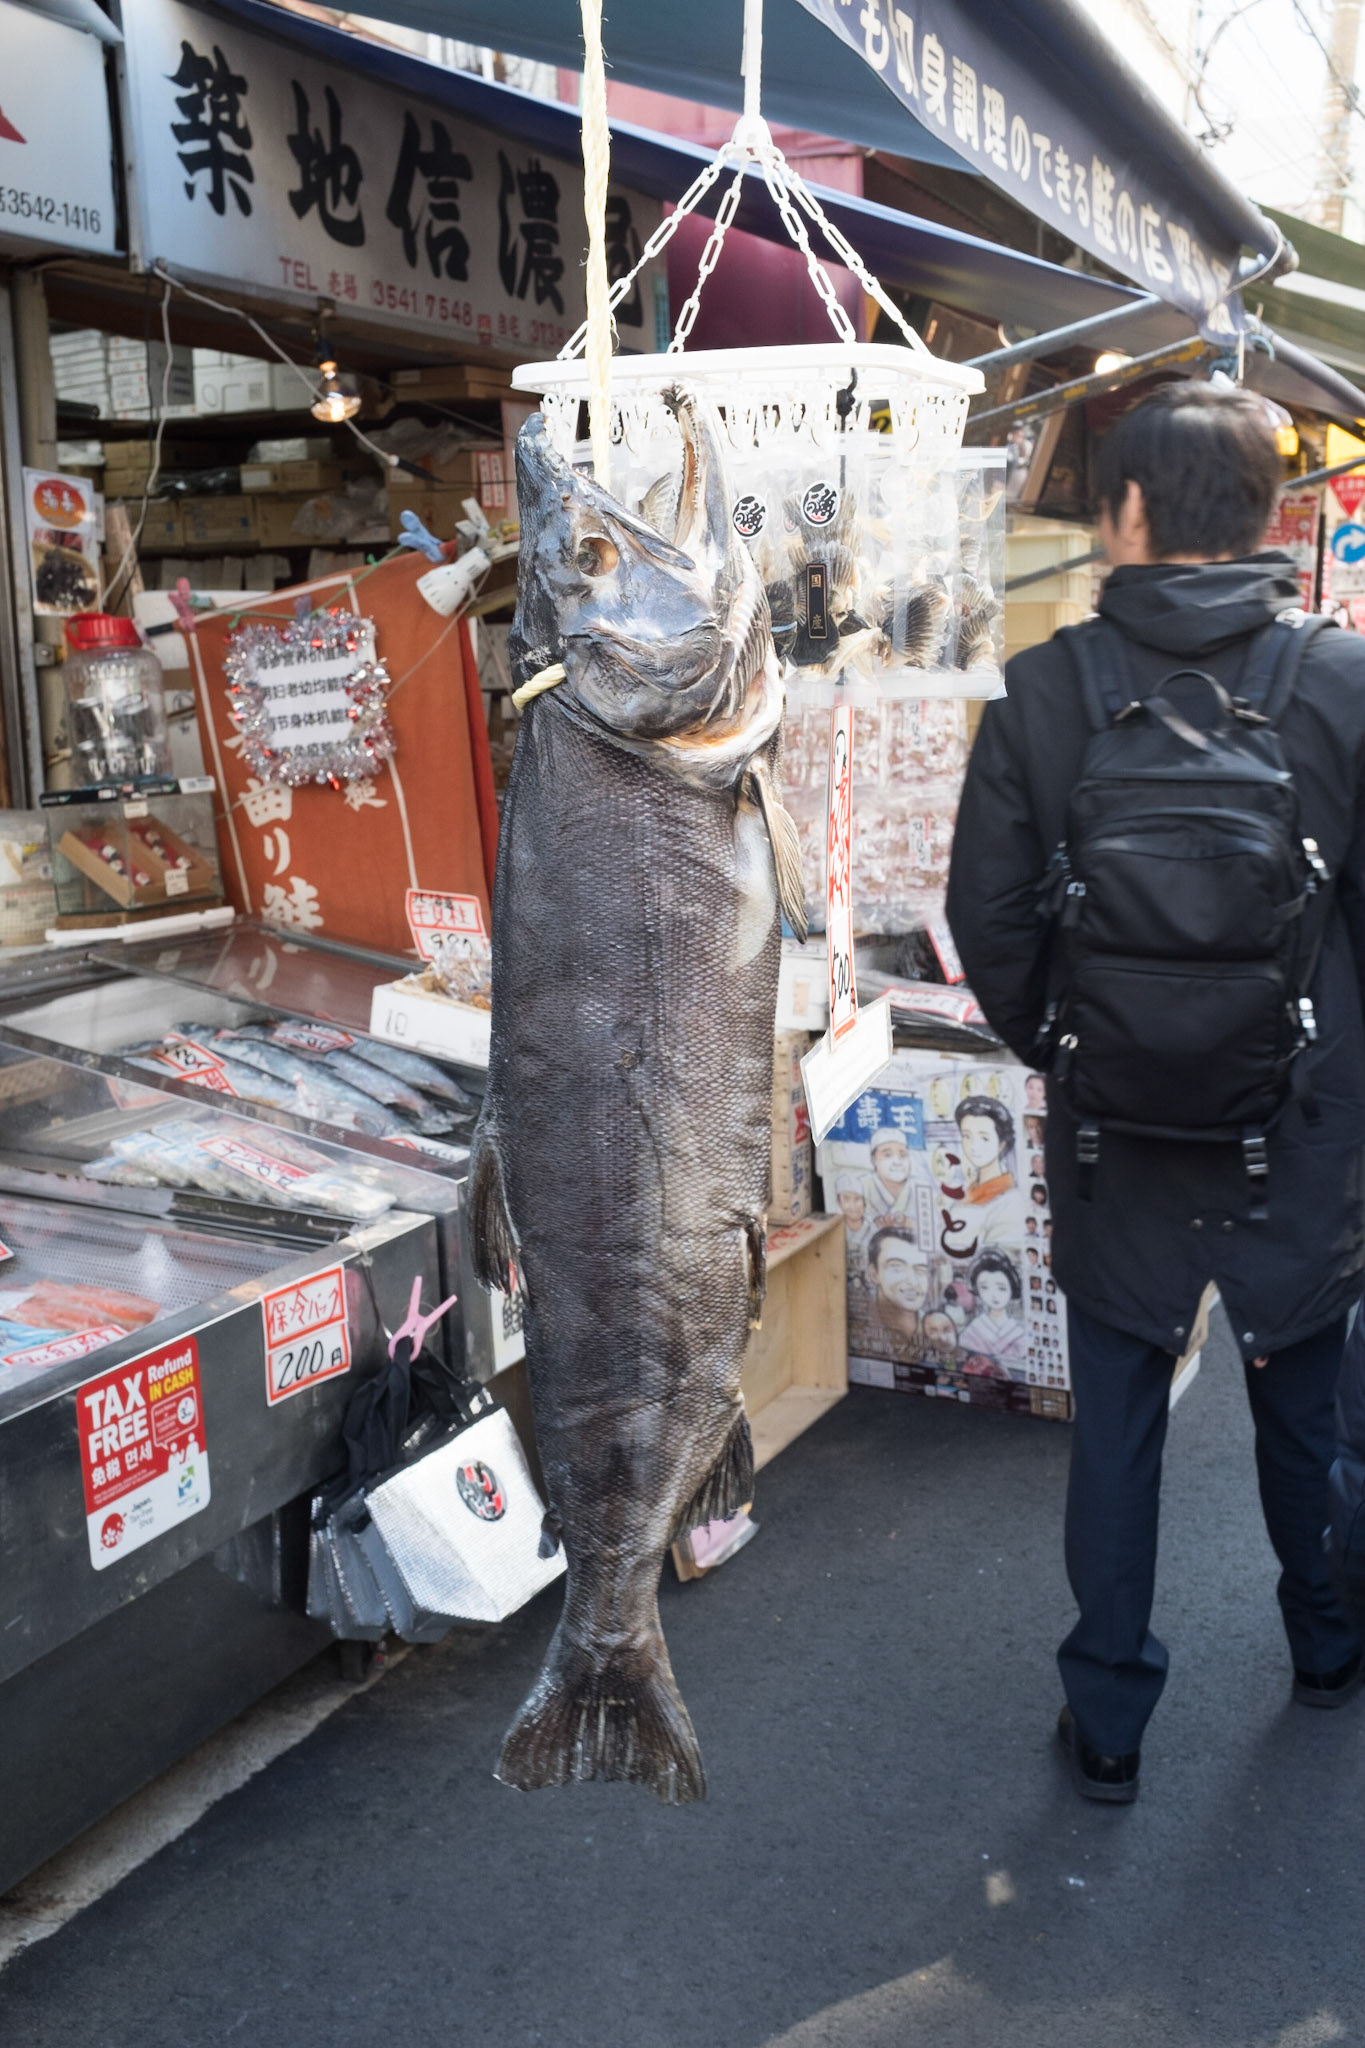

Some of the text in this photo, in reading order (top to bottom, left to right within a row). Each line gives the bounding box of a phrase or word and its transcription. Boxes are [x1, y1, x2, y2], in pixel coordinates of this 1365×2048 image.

[279, 256, 319, 292] TEL
[373, 280, 419, 315] 3541
[425, 295, 473, 327] 7548
[147, 1348, 193, 1385] Refund
[149, 1366, 195, 1402] IN CASH
[84, 1371, 146, 1430] TAX
[88, 1406, 149, 1464] FREE
